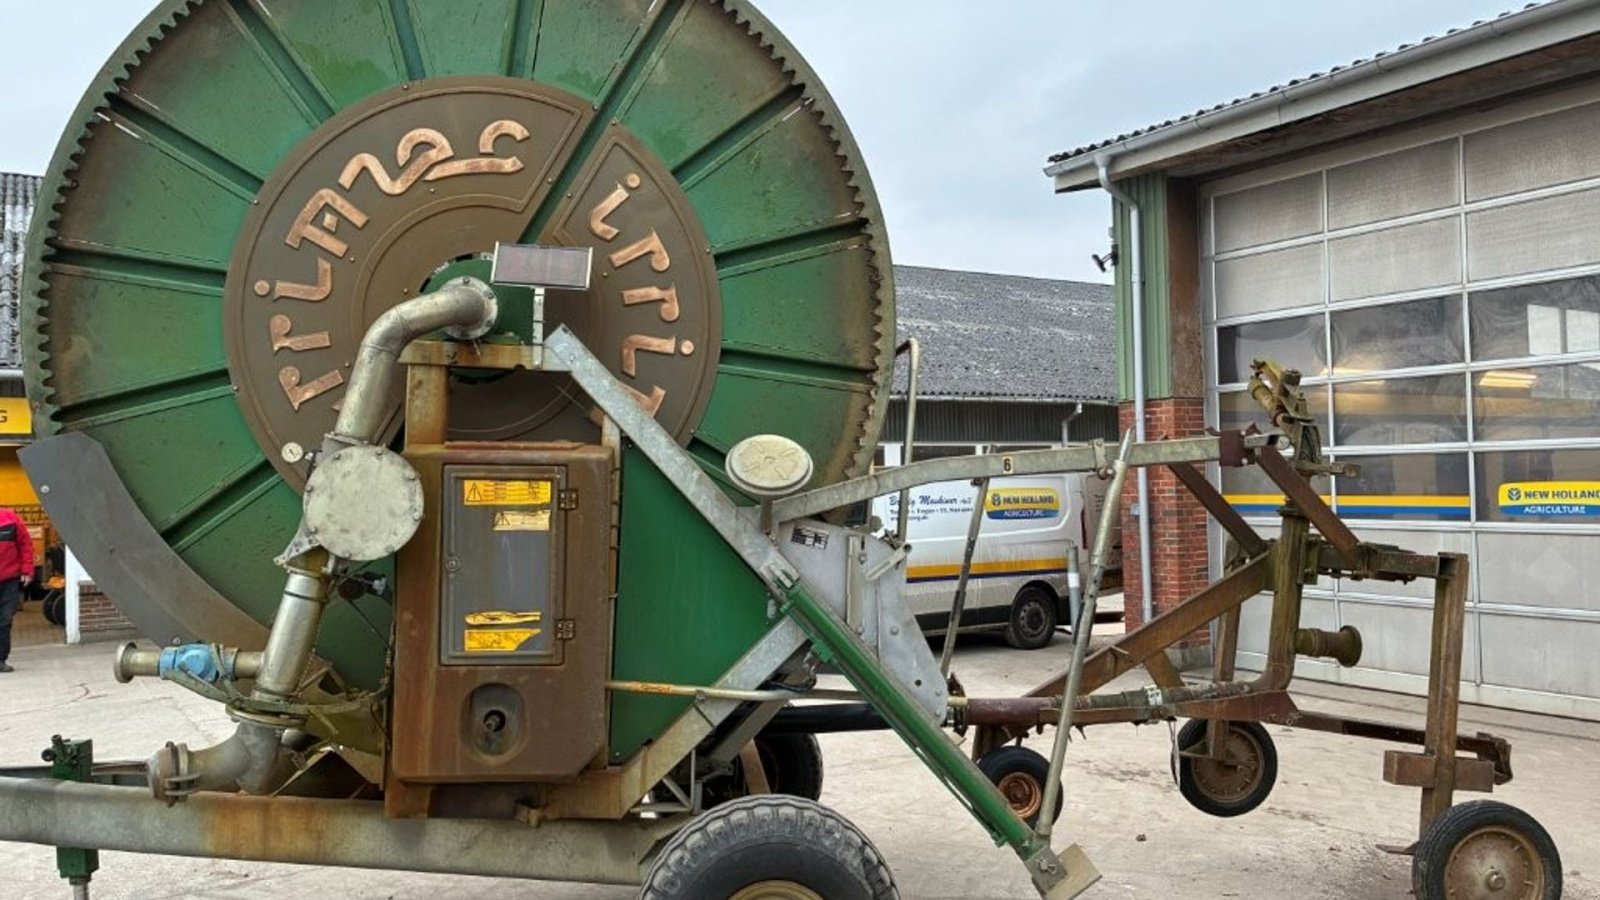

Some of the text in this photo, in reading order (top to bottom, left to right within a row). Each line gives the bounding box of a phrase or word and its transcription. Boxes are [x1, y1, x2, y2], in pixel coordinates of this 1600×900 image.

[1003, 458, 1012, 472] 6
[1524, 490, 1549, 499] NEW
[1003, 496, 1020, 505] NEW
[1523, 505, 1586, 514] AGRICULTURE
